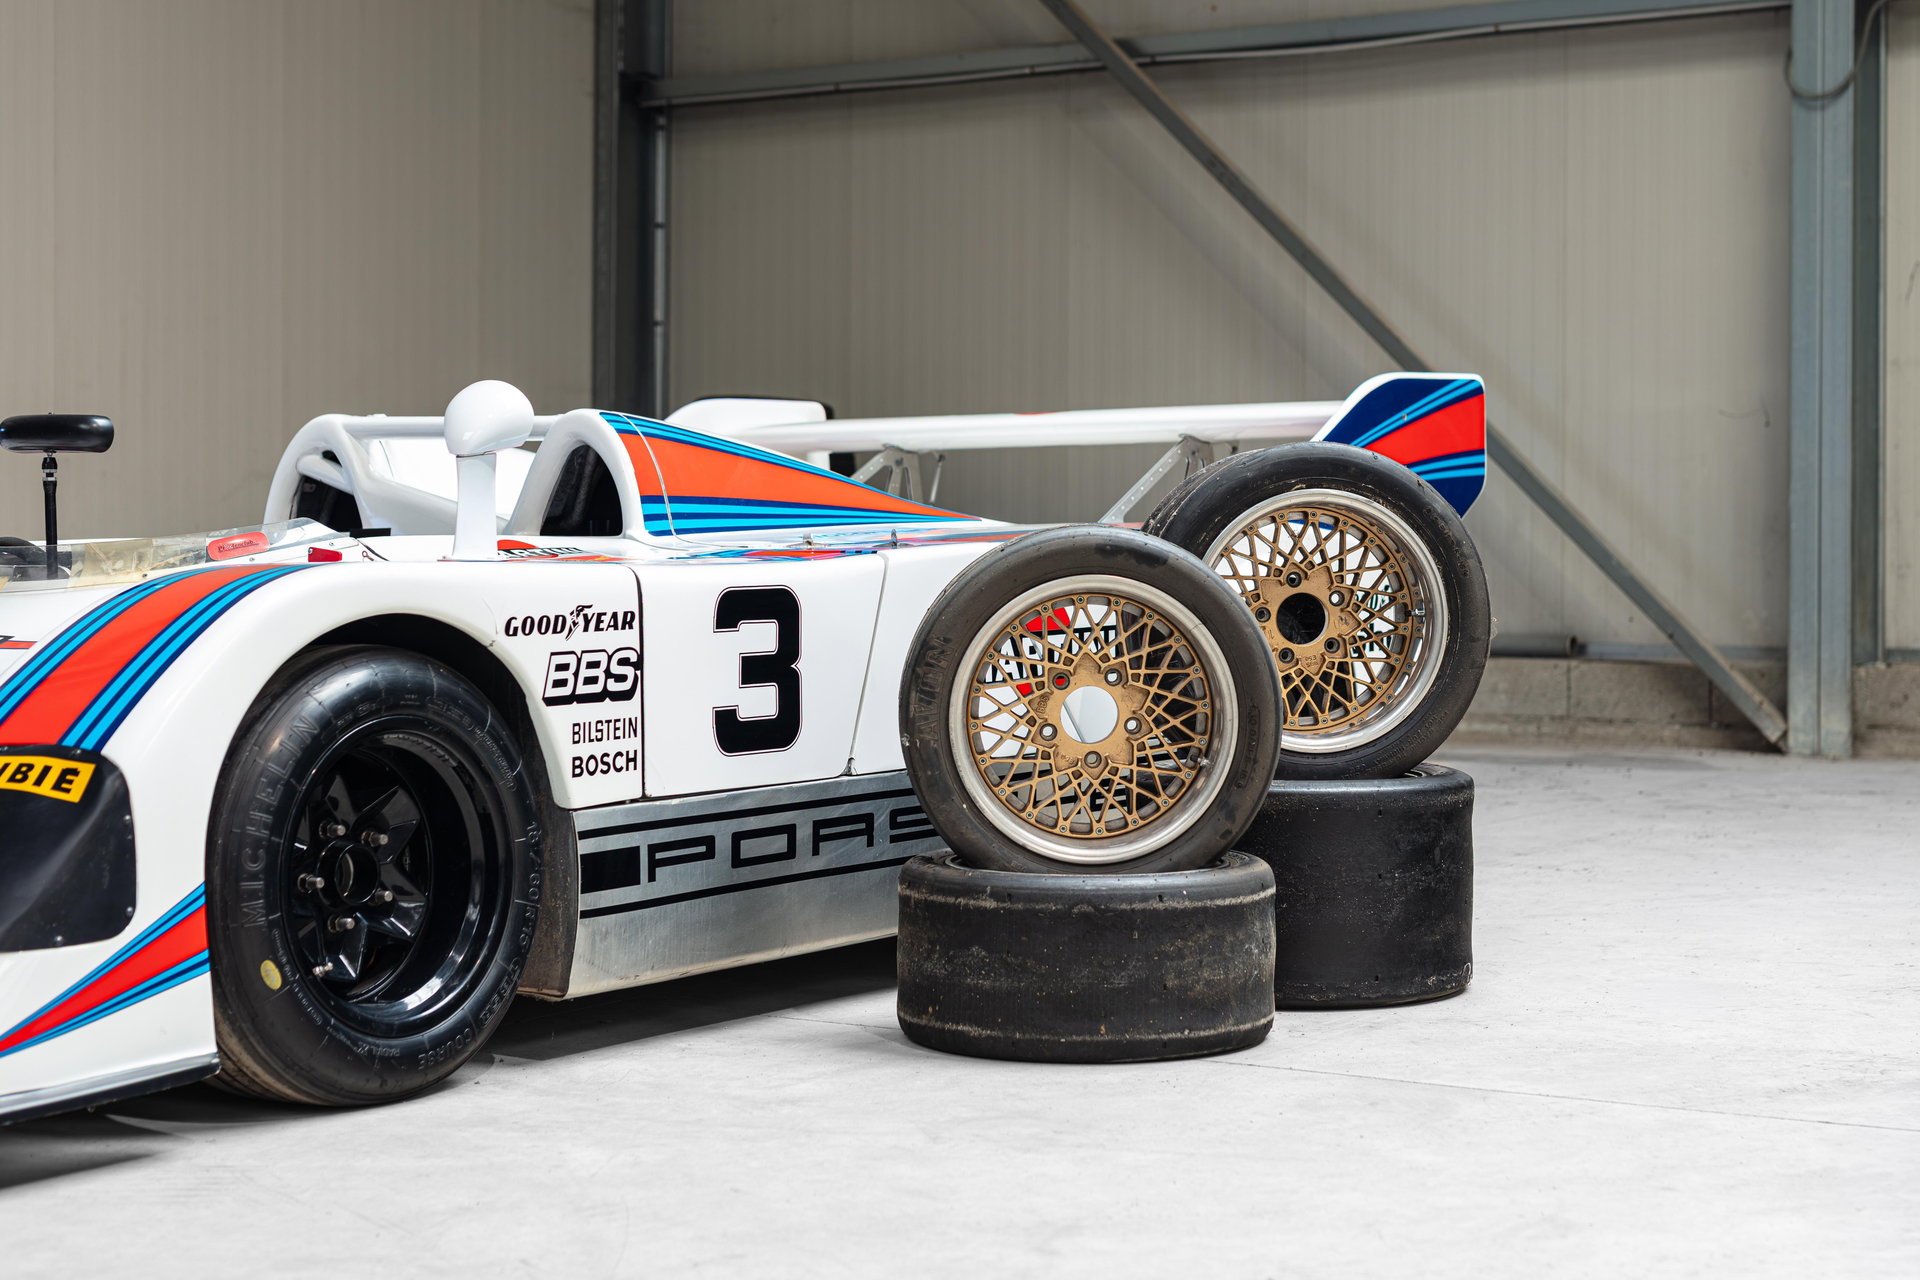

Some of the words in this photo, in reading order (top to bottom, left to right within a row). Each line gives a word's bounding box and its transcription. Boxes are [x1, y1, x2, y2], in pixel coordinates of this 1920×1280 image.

[504, 607, 636, 639] GOODYEAR
[542, 646, 641, 706] BBS
[712, 584, 803, 757] 3
[571, 716, 638, 745] BILSTEIN
[571, 749, 638, 779] BOSCH
